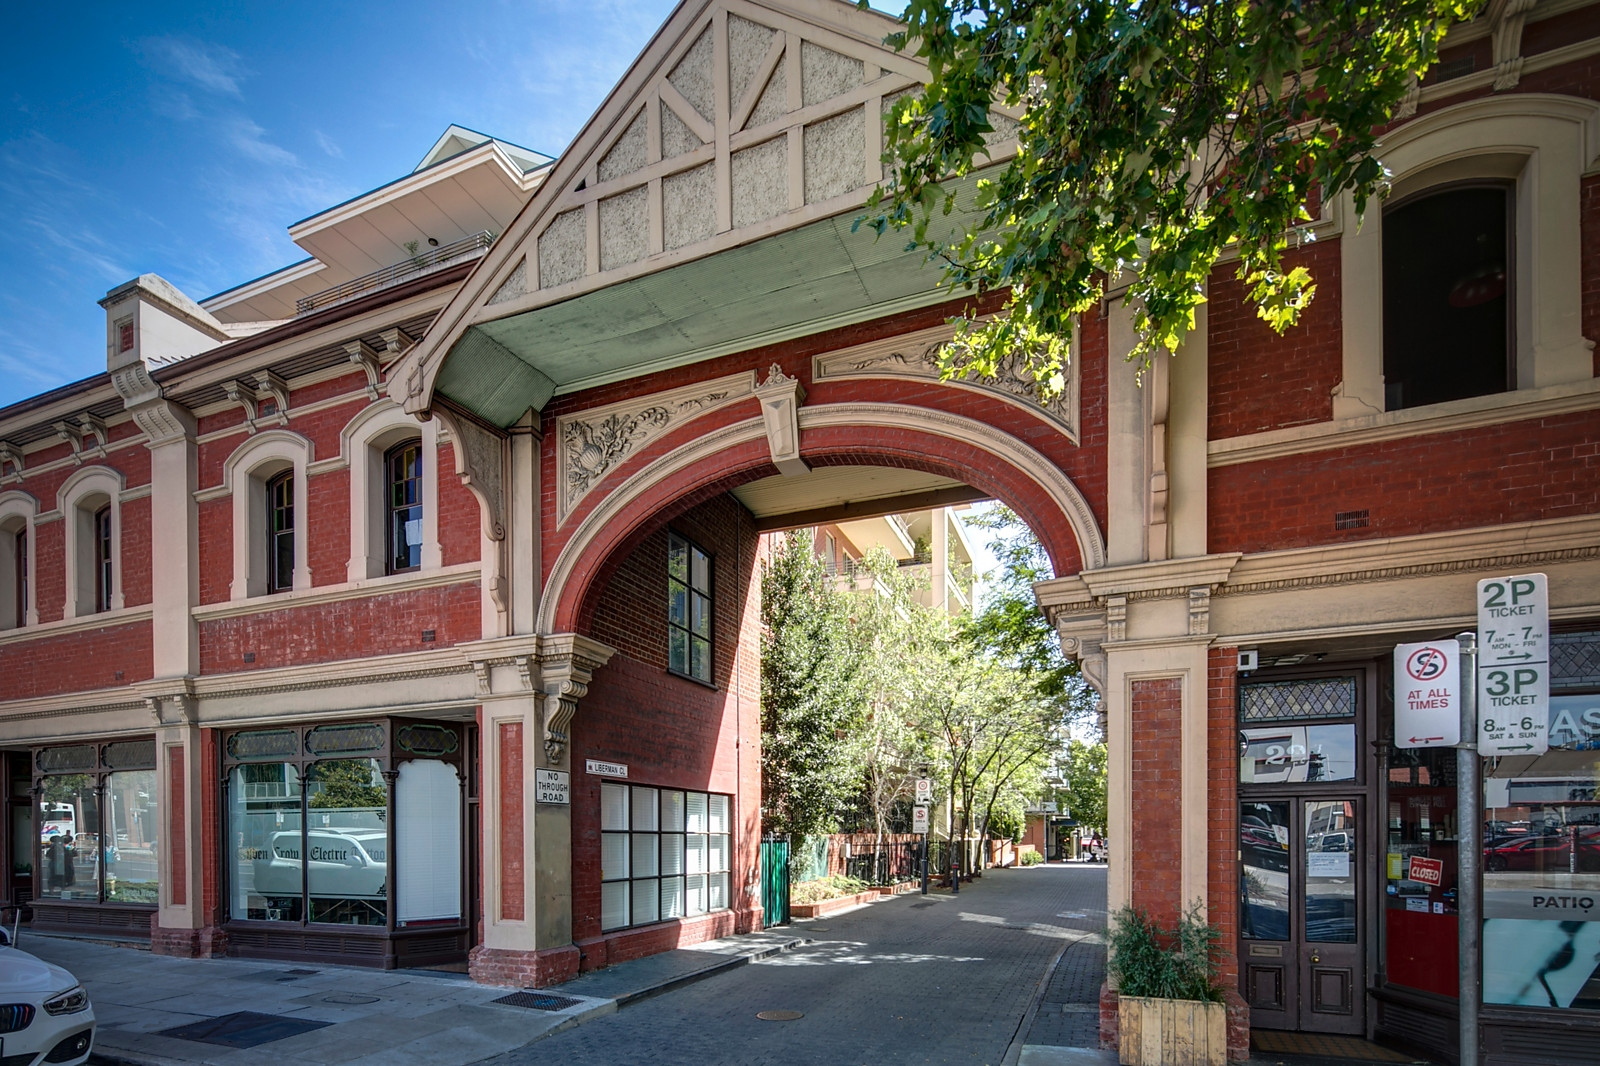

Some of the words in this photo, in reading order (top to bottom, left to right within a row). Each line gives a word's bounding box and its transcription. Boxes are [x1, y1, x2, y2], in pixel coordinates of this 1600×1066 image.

[1484, 580, 1536, 609] 2P
[1488, 604, 1535, 618] TICKET
[1486, 668, 1538, 696] 3P
[1407, 690, 1422, 700] AT
[1427, 688, 1451, 698] ALL
[1490, 694, 1537, 707] TICKET
[1407, 698, 1449, 710] TIMES
[594, 763, 618, 774] LIBERMAN
[619, 767, 626, 775] CL
[547, 772, 559, 781] NO
[538, 781, 568, 792] THROUGH
[543, 793, 564, 802] ROAD
[310, 846, 347, 861] Electric
[1411, 866, 1439, 881] CLOSED
[1532, 896, 1594, 913] PATIO
